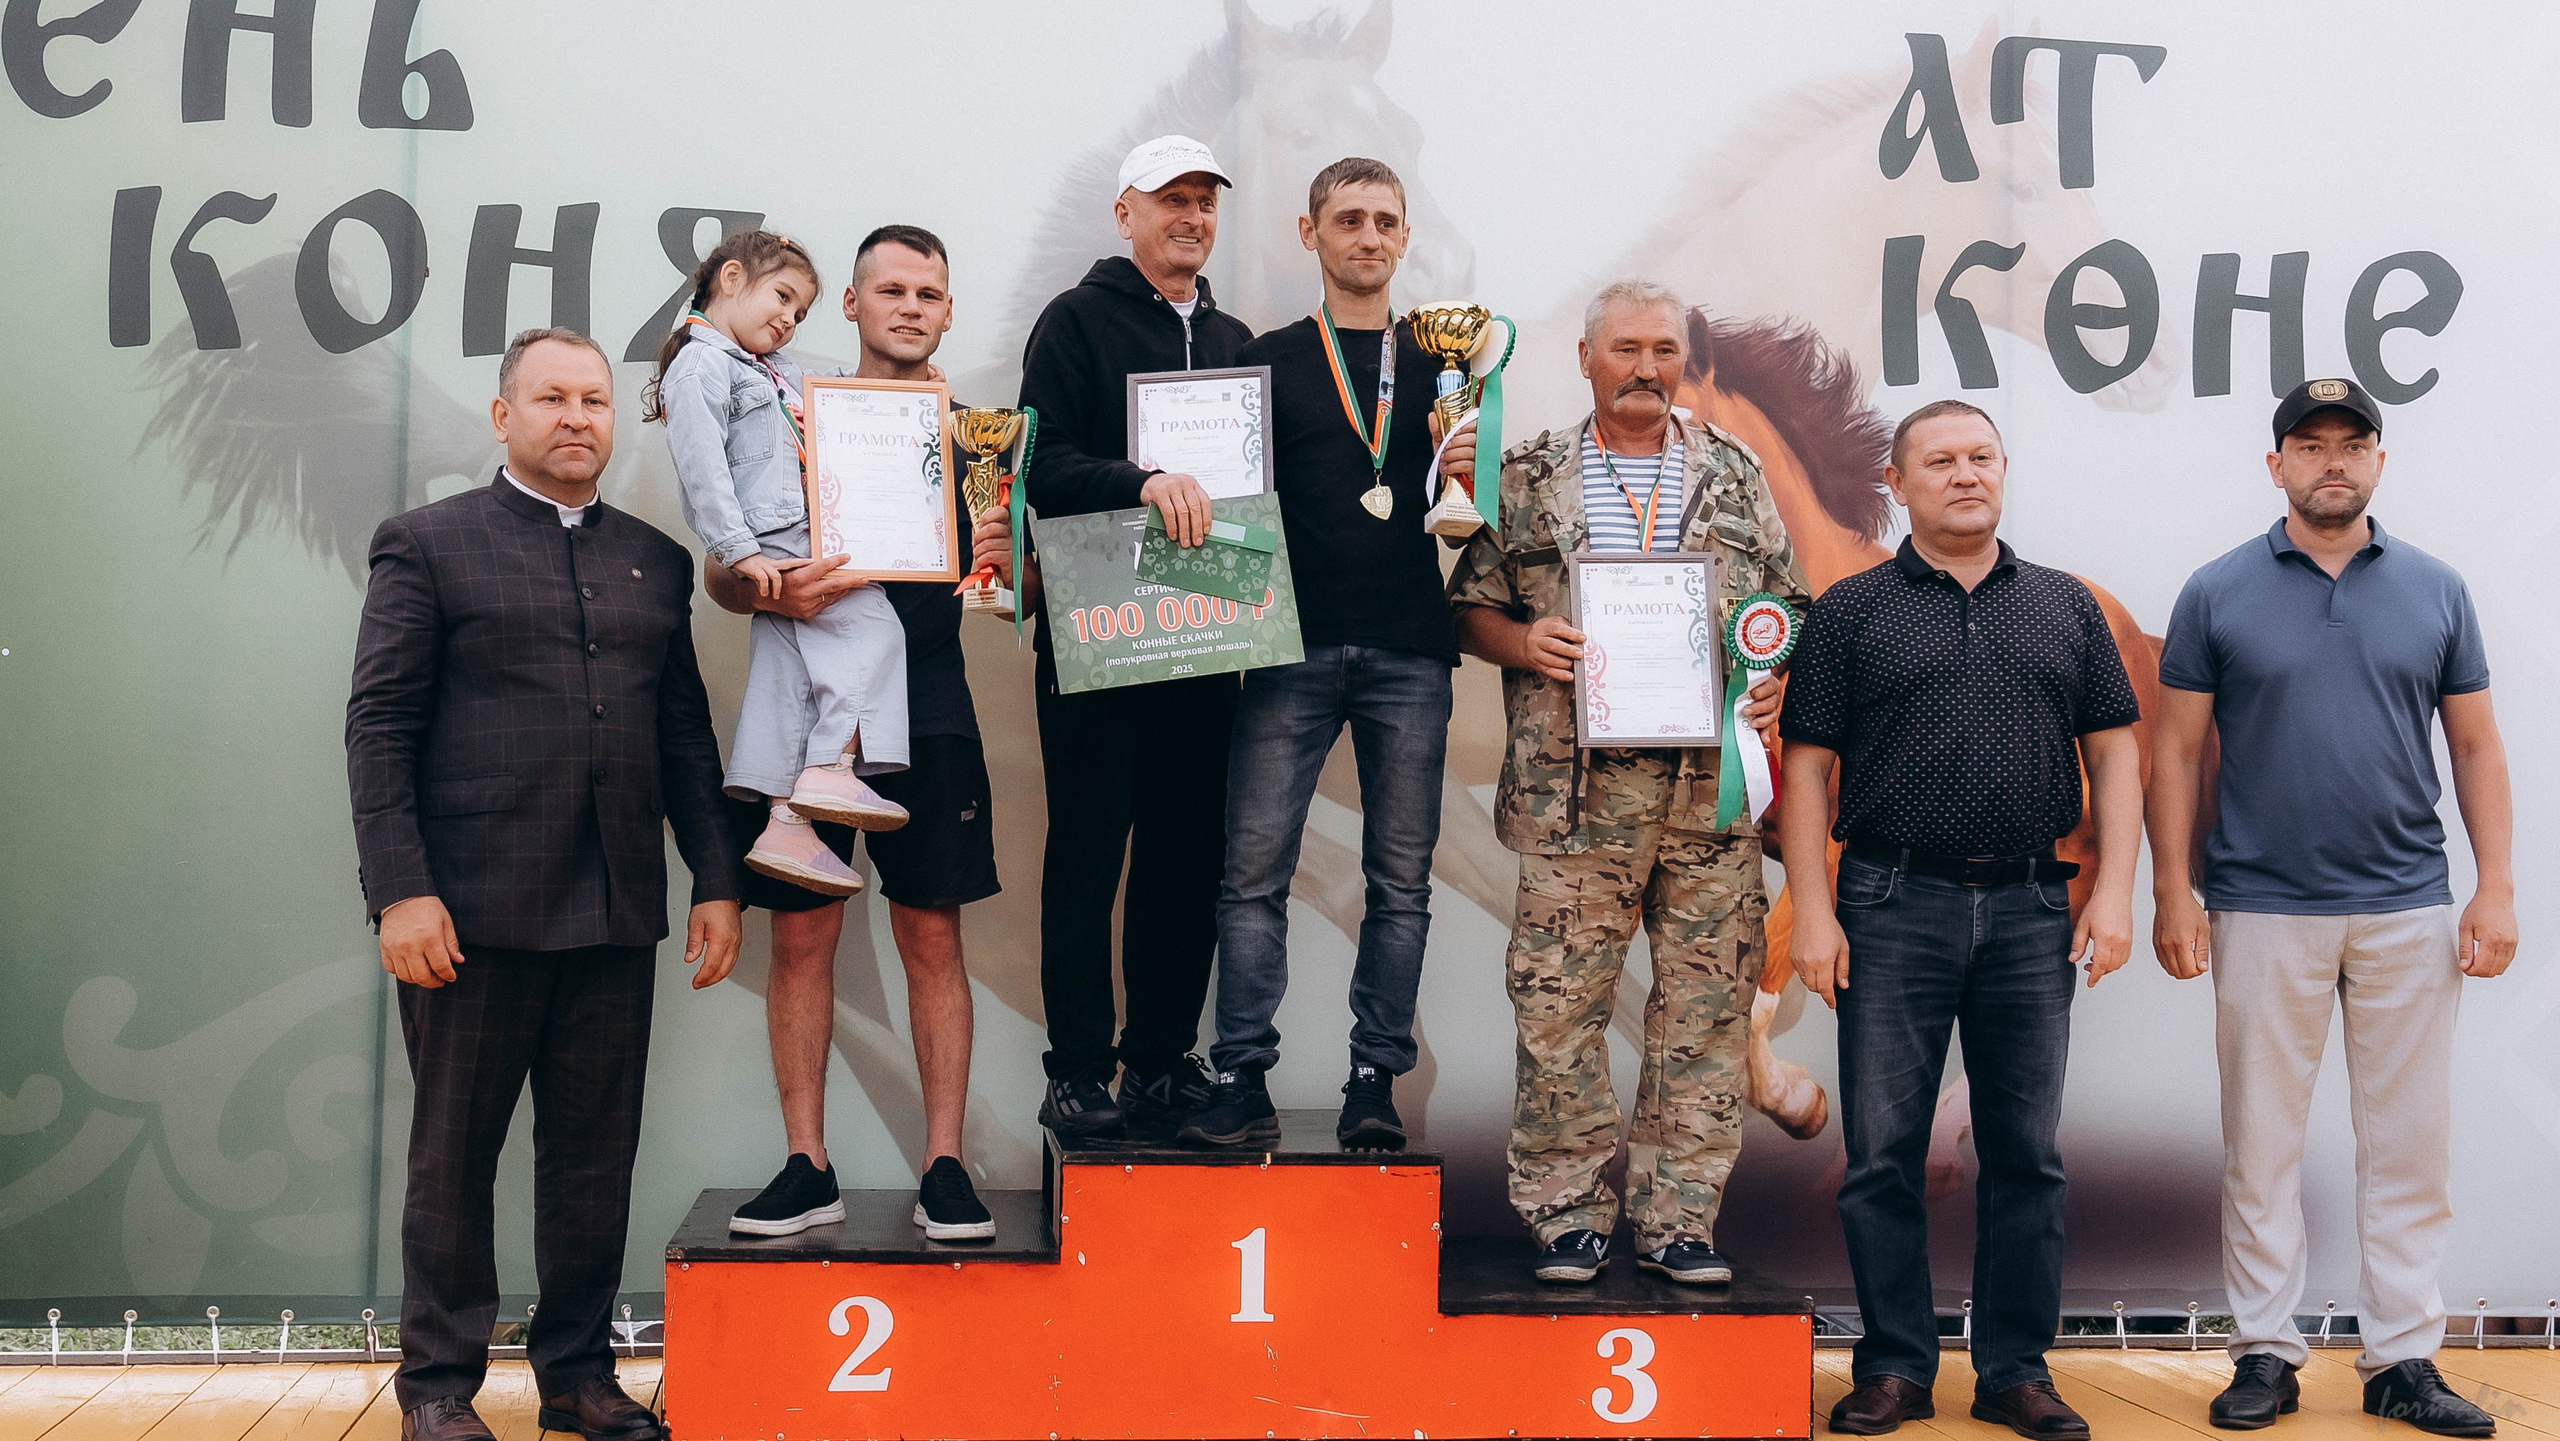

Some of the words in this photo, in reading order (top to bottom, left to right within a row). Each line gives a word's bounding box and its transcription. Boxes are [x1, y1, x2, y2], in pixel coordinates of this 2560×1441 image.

[1160, 417, 1240, 433] ГРАМОТА
[838, 432, 920, 448] ГРАМОТА
[1134, 584, 1181, 597] СЕРТИ
[1069, 601, 1145, 643] 100
[1156, 592, 1238, 632] 000
[1603, 602, 1686, 616] ГРАМОТА
[1132, 636, 1178, 651] КОННЫЕ
[1180, 629, 1224, 645] СКАЧКИ
[1105, 650, 1169, 668] (полукровная
[1170, 645, 1214, 660] верховая
[1215, 638, 1254, 653] лошадь)
[1171, 663, 1194, 676] 2025
[1229, 1227, 1275, 1323] 1
[827, 1295, 895, 1393] 2
[1591, 1328, 1658, 1425] 3
